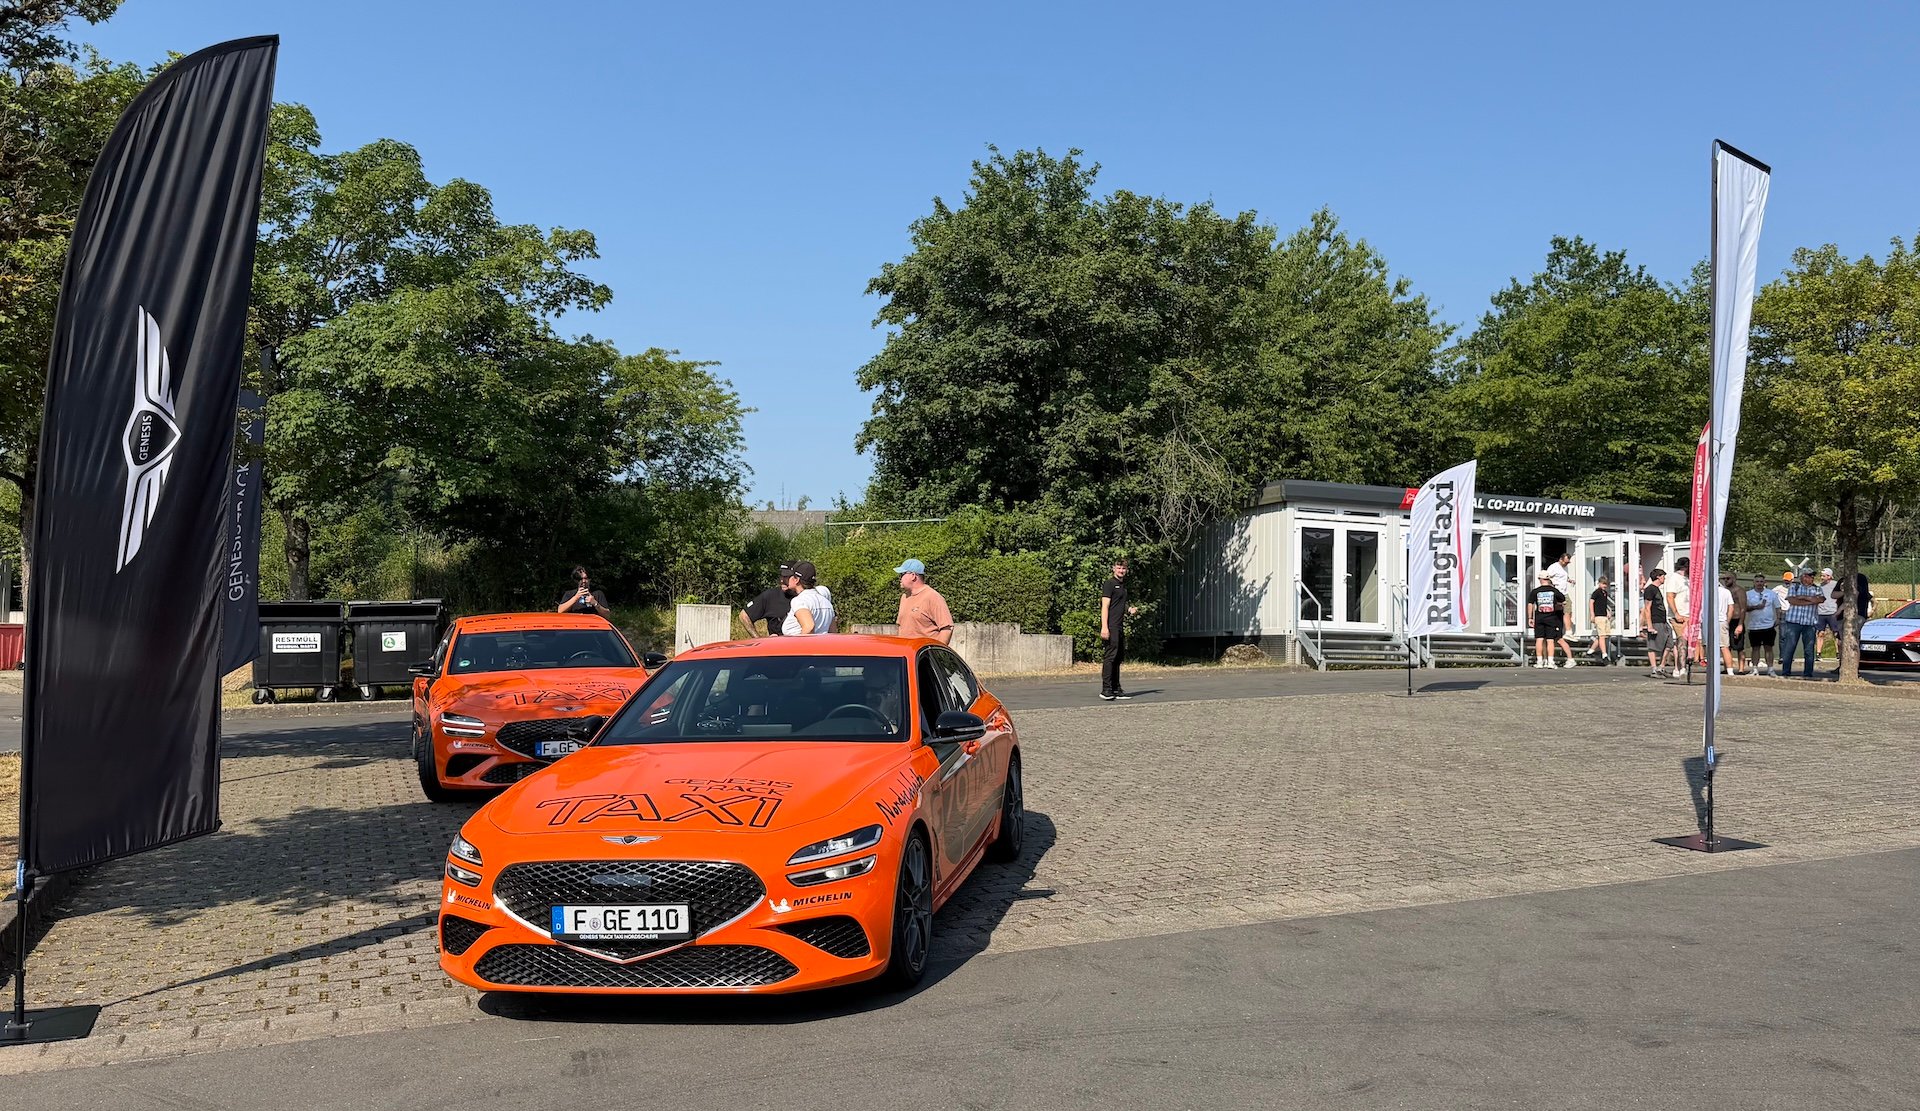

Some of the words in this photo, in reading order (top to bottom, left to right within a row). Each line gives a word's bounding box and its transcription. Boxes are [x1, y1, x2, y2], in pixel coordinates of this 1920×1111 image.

[138, 414, 153, 461] GENESIS
[1487, 498, 1543, 513] CO-PILOT
[1543, 502, 1596, 517] PARTNER
[1426, 480, 1458, 626] RingTaxi
[275, 635, 318, 643] RESTMÜLL
[543, 743, 551, 754] F
[559, 741, 575, 753] GE
[664, 778, 794, 789] GENESIS
[688, 785, 785, 797] TRACK
[536, 793, 783, 828] TAXI
[455, 894, 492, 910] MICHELIN
[793, 891, 853, 907] MICHELIN
[574, 909, 588, 931] F
[603, 909, 632, 931] GE
[637, 908, 679, 931] 110
